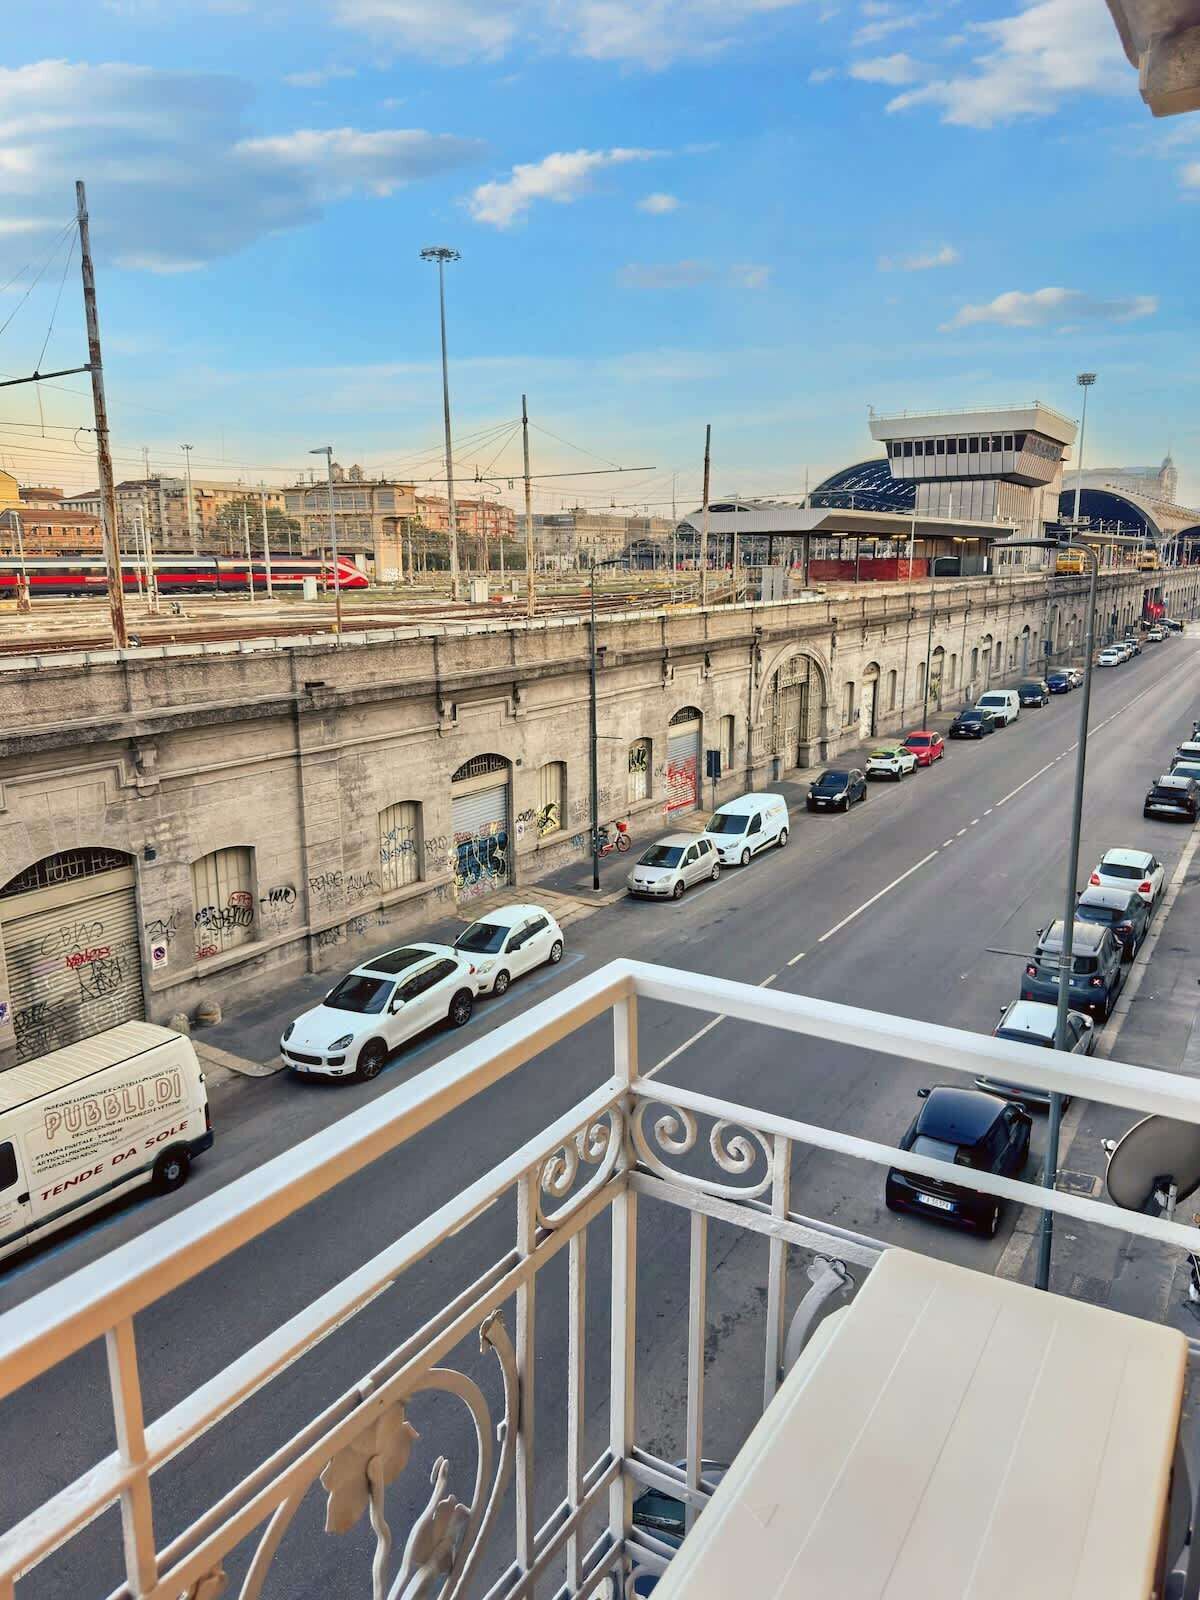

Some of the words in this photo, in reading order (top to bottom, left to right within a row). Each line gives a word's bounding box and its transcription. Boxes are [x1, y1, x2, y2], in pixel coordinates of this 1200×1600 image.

[44, 1073, 182, 1140] PUBBLI.DI
[35, 1148, 63, 1160] STAMPA
[64, 1137, 94, 1151] DIGITALE
[40, 1163, 105, 1201] TENDE
[111, 1147, 138, 1167] DA
[144, 1120, 190, 1149] SOLE
